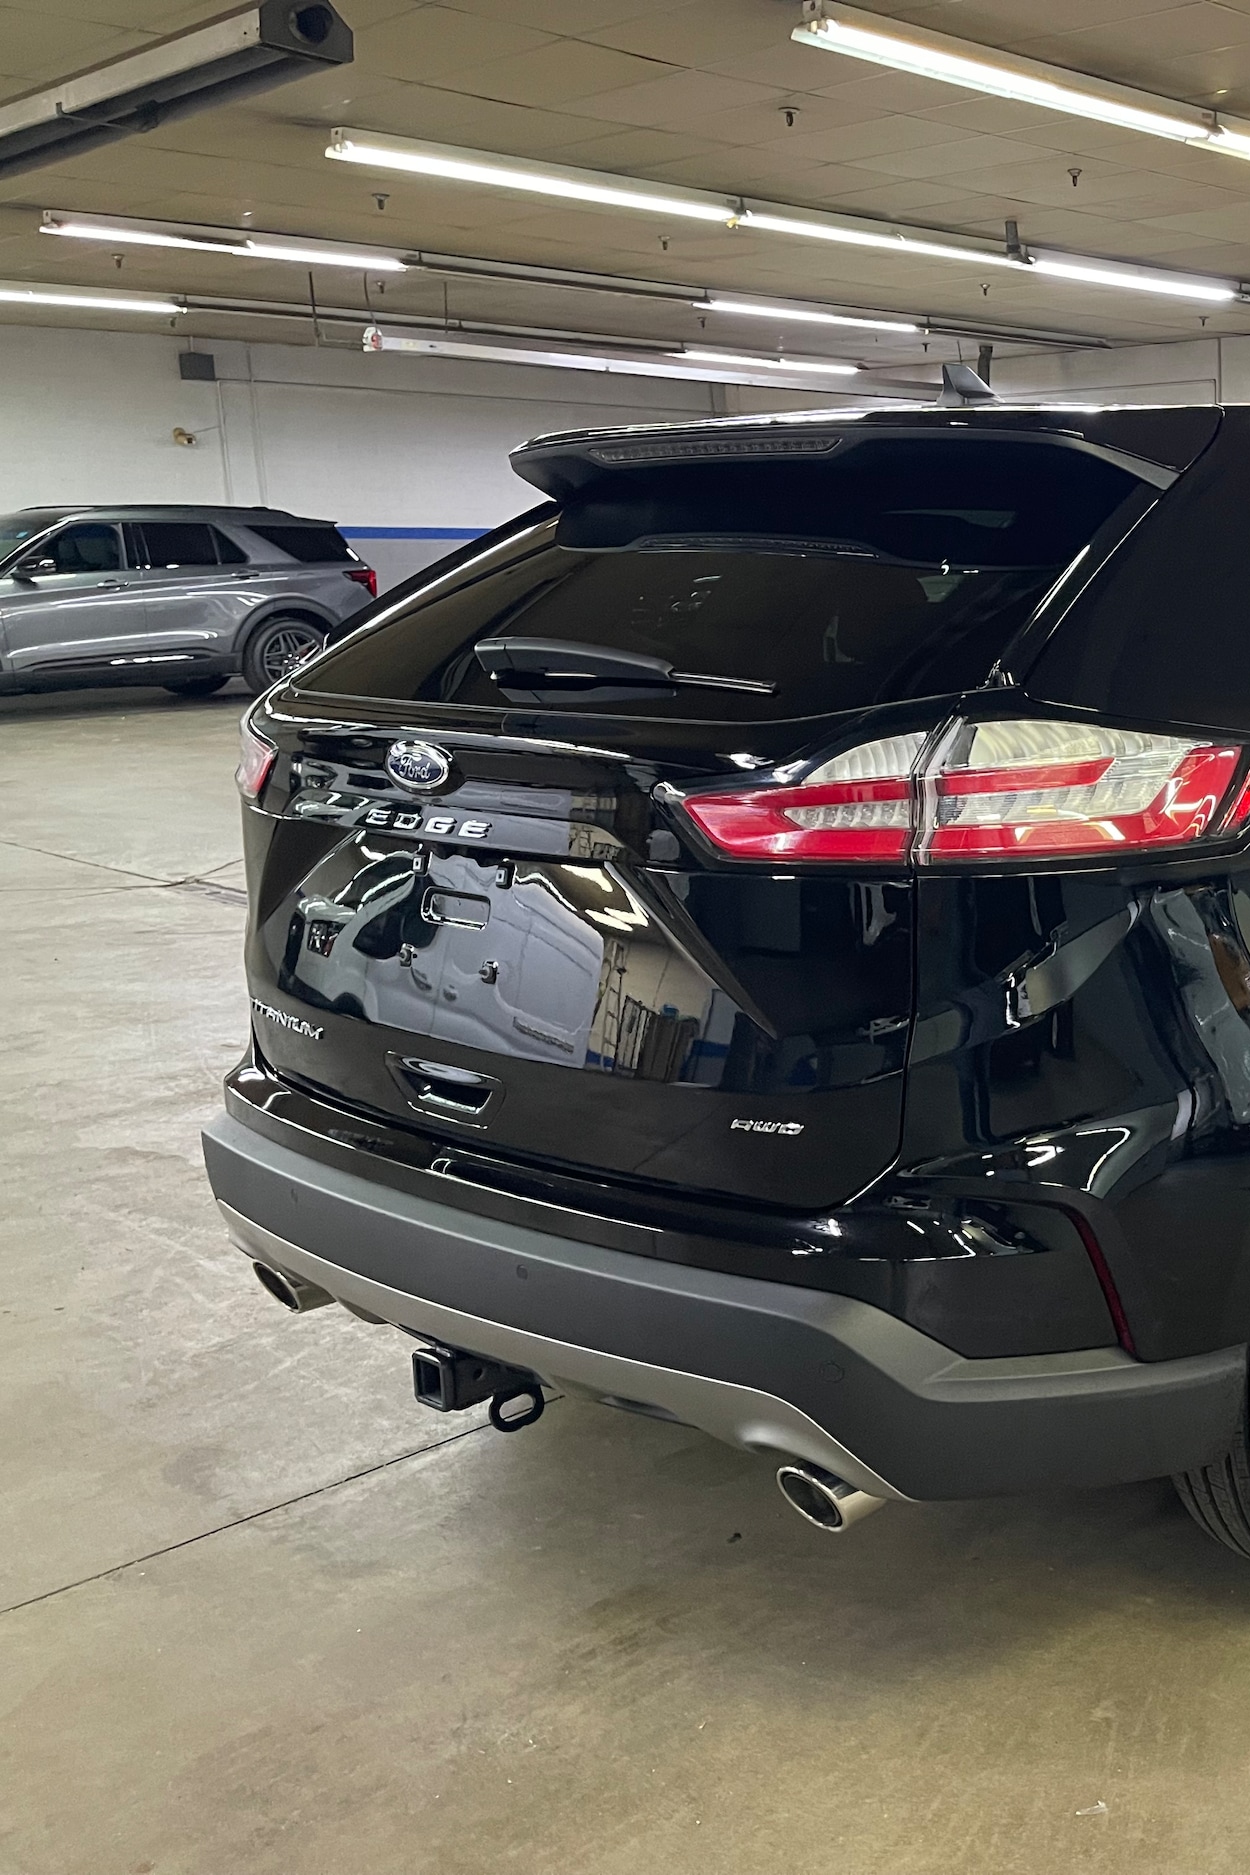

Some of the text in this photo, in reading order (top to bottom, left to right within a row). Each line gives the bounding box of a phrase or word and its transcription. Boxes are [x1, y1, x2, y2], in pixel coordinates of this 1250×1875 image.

[399, 753, 431, 779] Ford
[365, 808, 492, 838] EDGE
[730, 1118, 805, 1136] AWD
